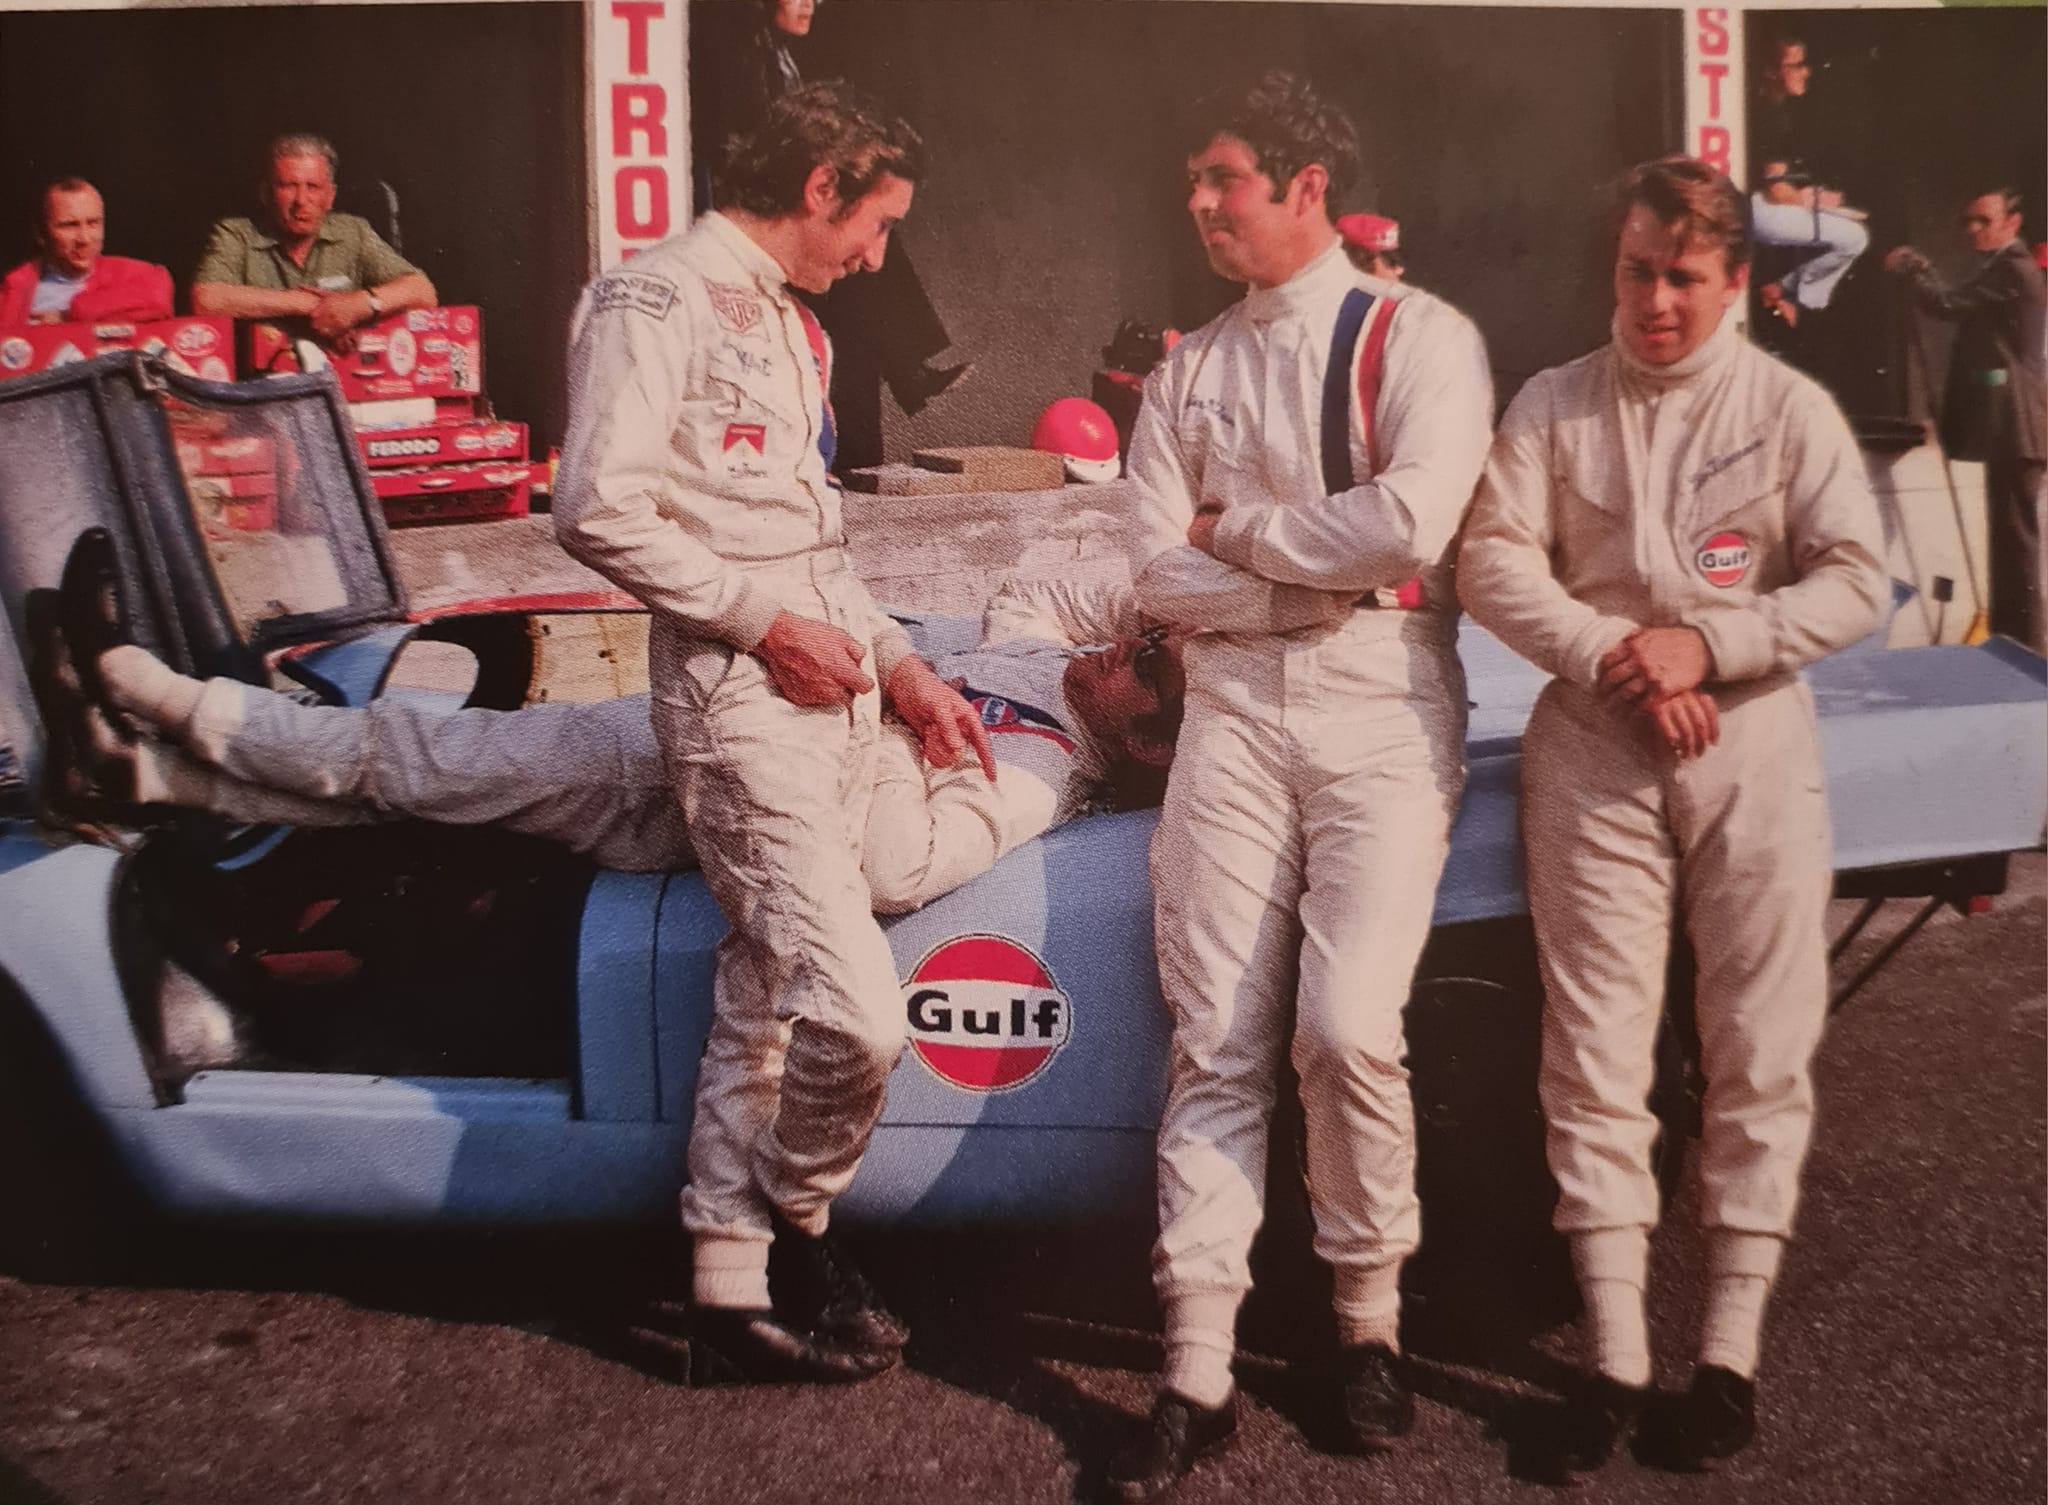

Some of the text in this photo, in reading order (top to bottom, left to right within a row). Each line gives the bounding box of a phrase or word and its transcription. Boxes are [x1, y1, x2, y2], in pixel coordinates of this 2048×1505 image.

[611, 1, 670, 263] TRO
[367, 437, 441, 457] FERODO
[1701, 551, 1748, 569] Gulf
[906, 988, 1061, 1038] Gulf
